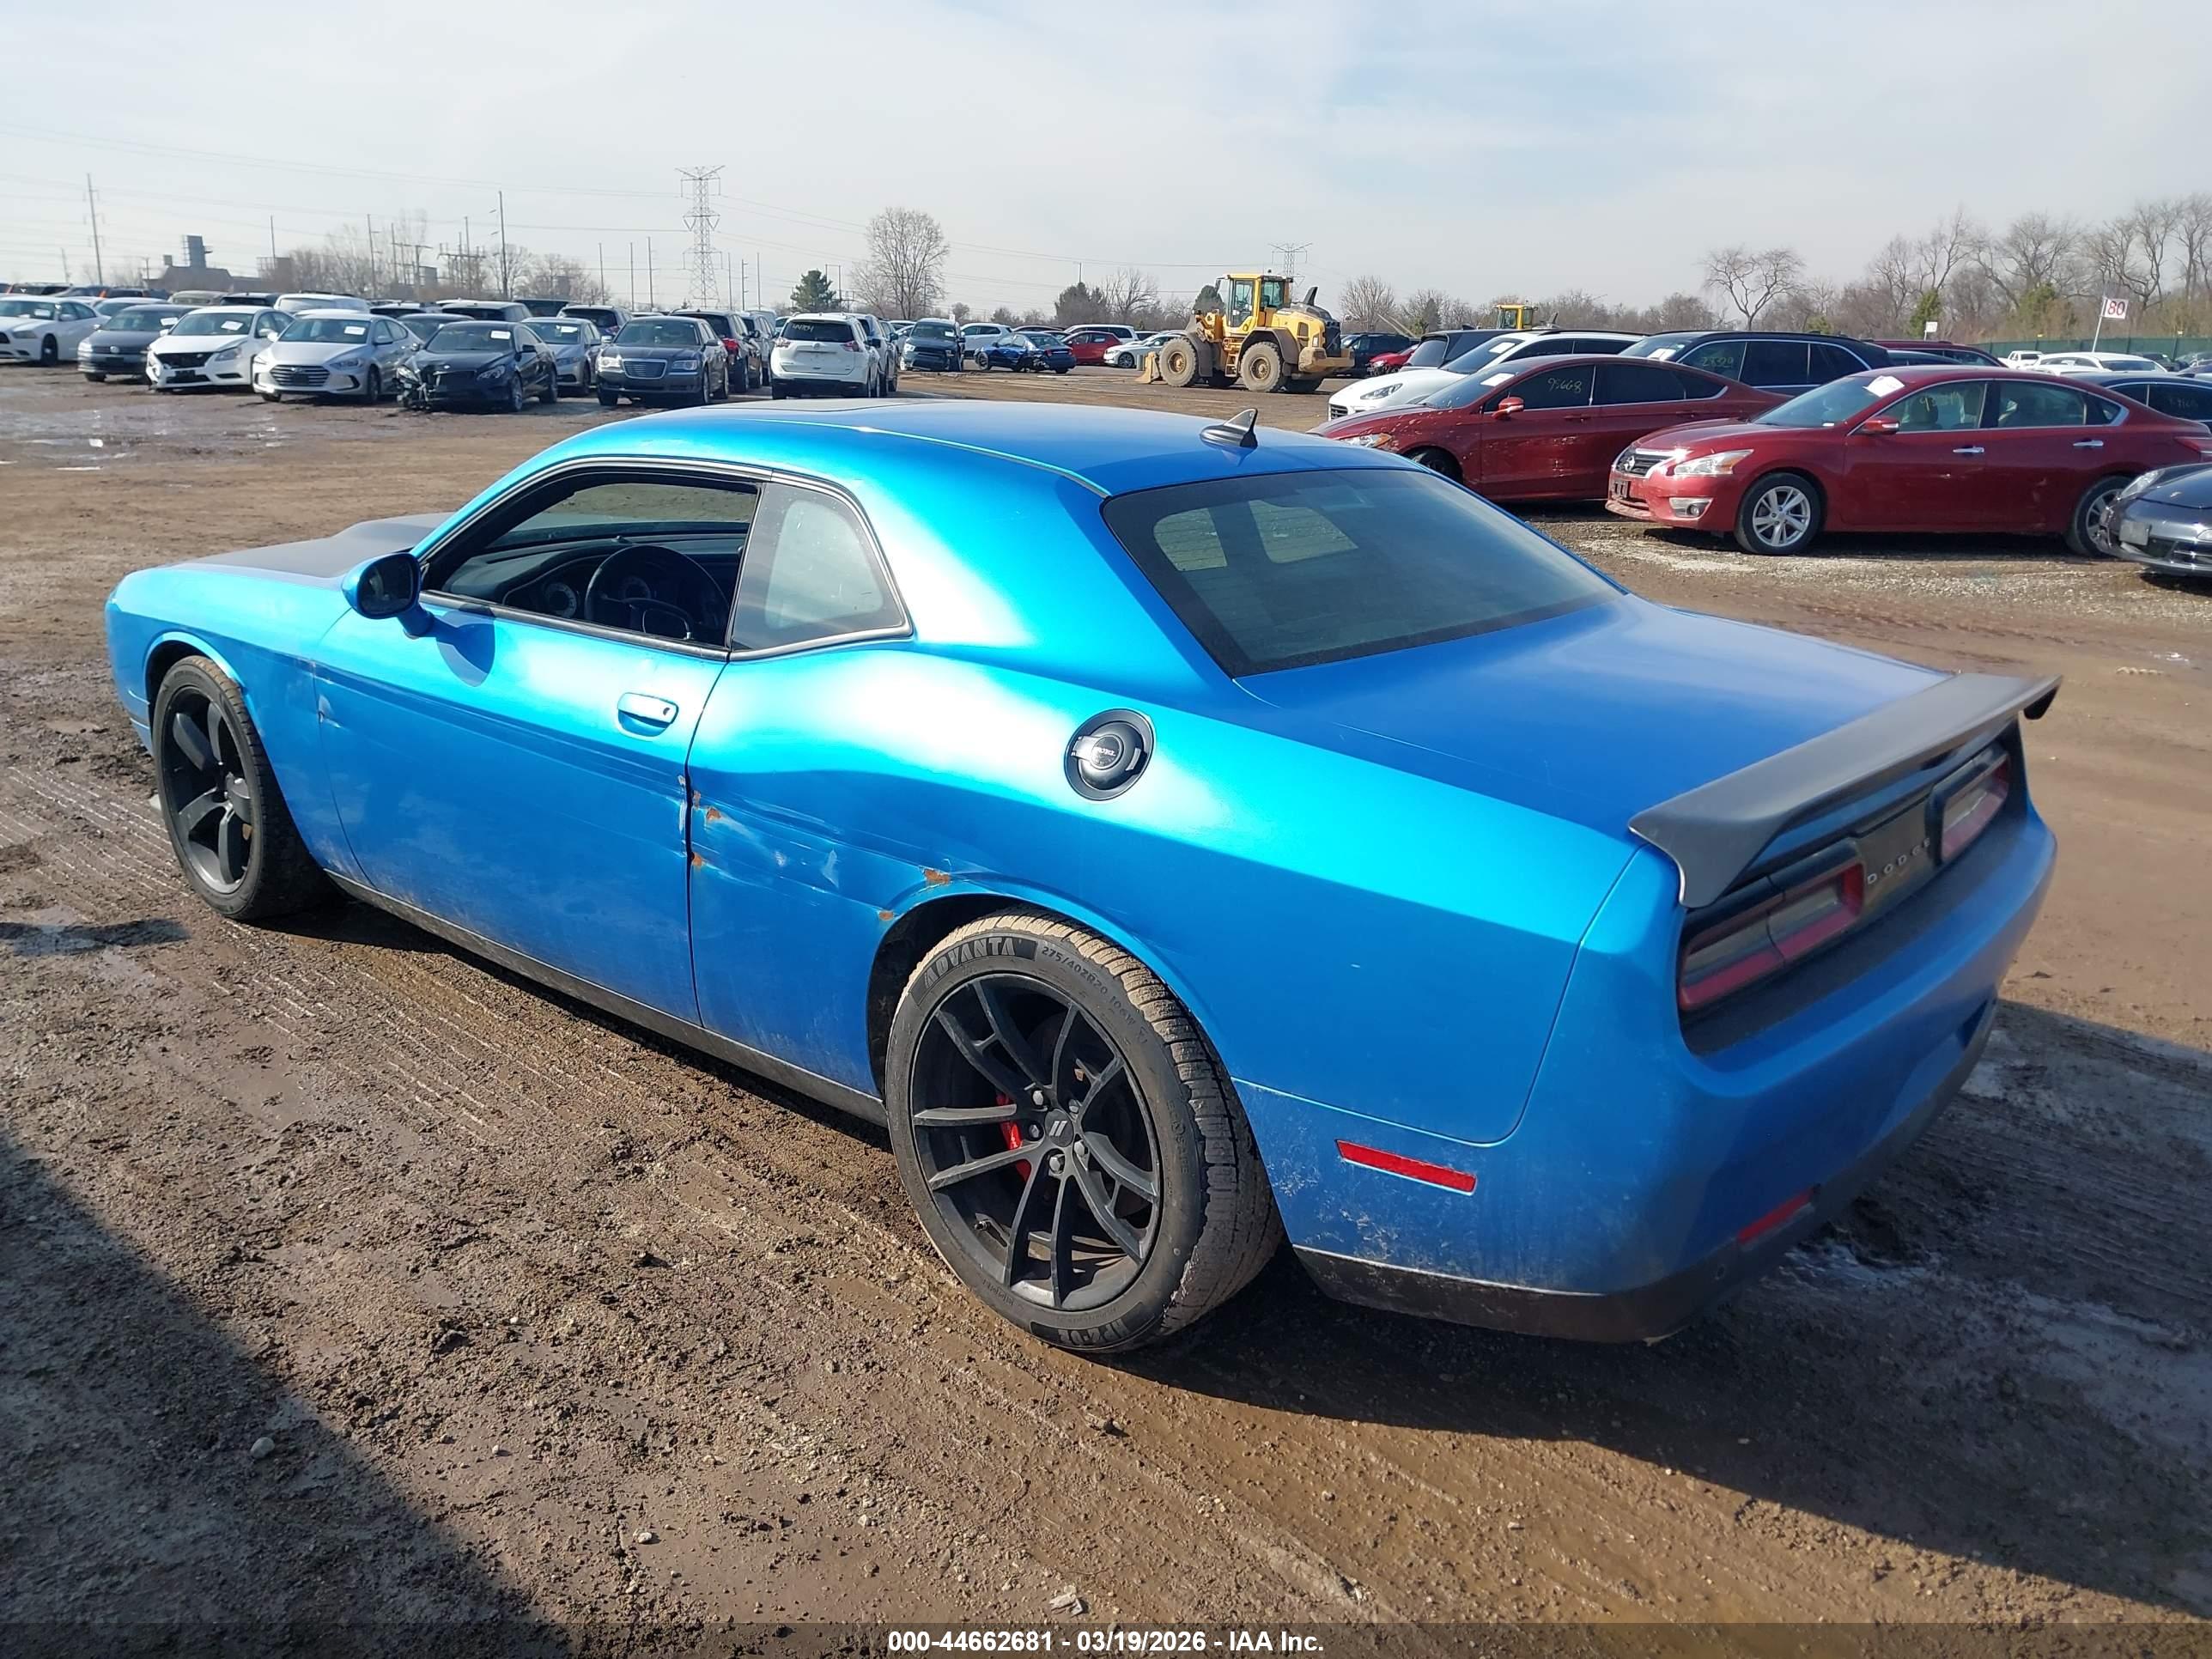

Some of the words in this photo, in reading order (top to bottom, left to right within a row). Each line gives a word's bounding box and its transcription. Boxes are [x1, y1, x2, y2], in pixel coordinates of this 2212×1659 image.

[2108, 301, 2126, 316] 80
[1868, 838, 1930, 884] DODGE
[924, 936, 1016, 989] ADVANTA
